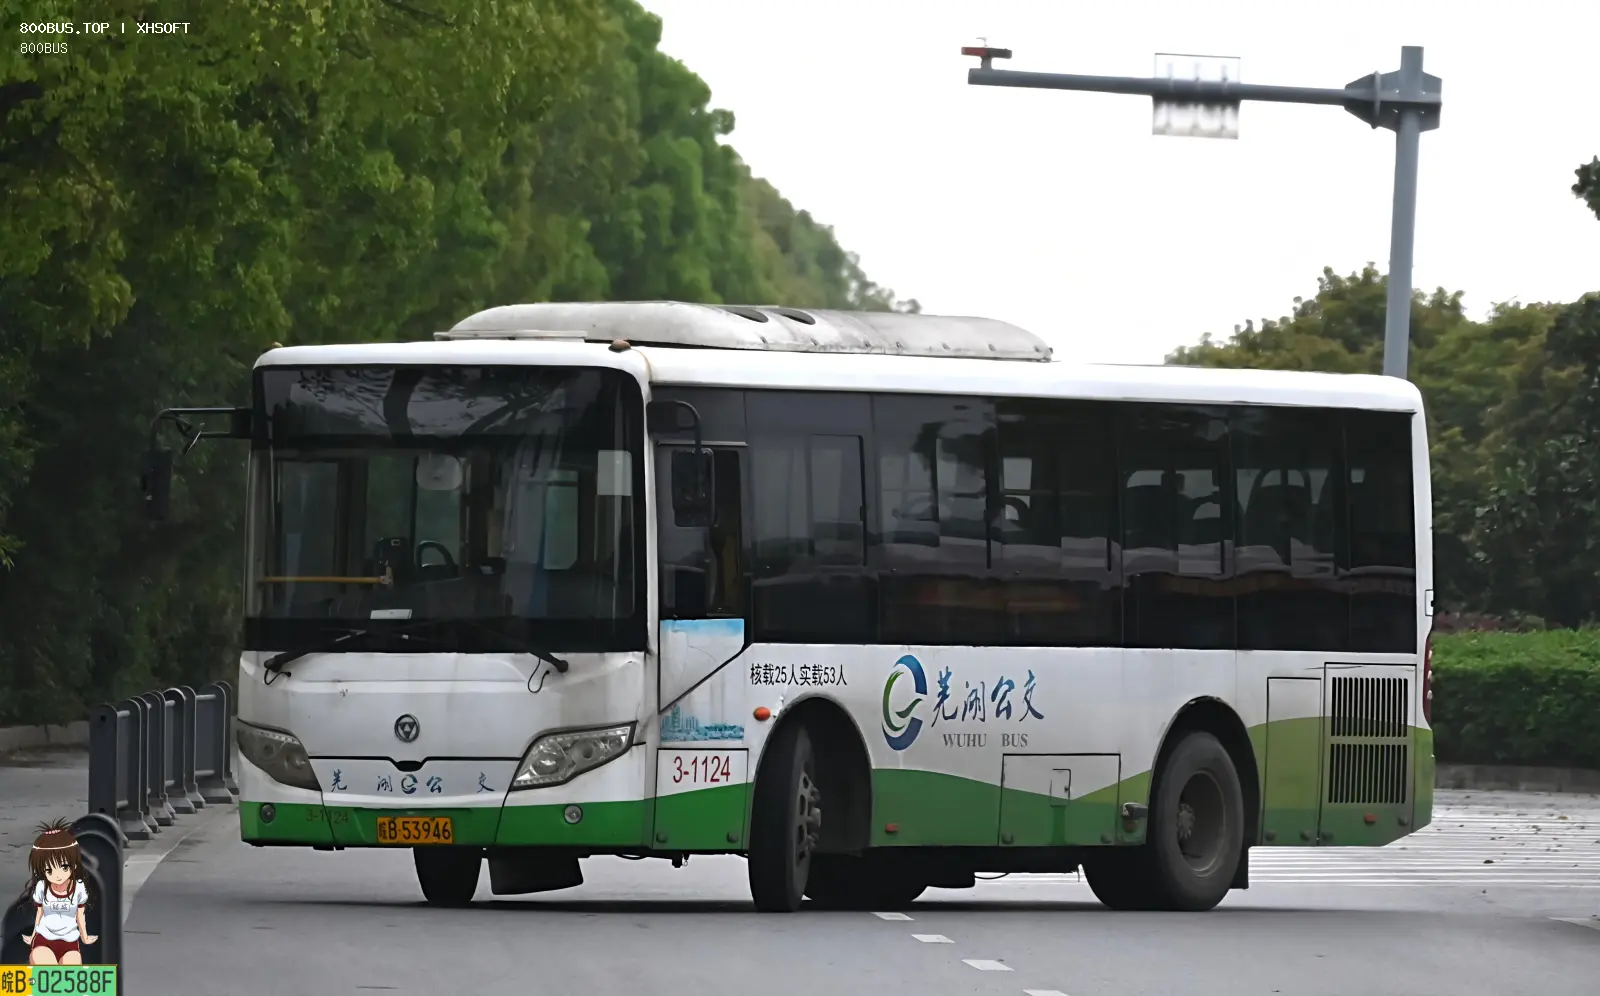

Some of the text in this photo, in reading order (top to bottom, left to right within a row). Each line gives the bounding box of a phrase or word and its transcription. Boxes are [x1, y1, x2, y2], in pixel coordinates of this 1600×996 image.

[750, 663, 848, 686] 核载25人实载53人
[943, 733, 1028, 748] WUHU BUS
[673, 755, 731, 783] 3-1124
